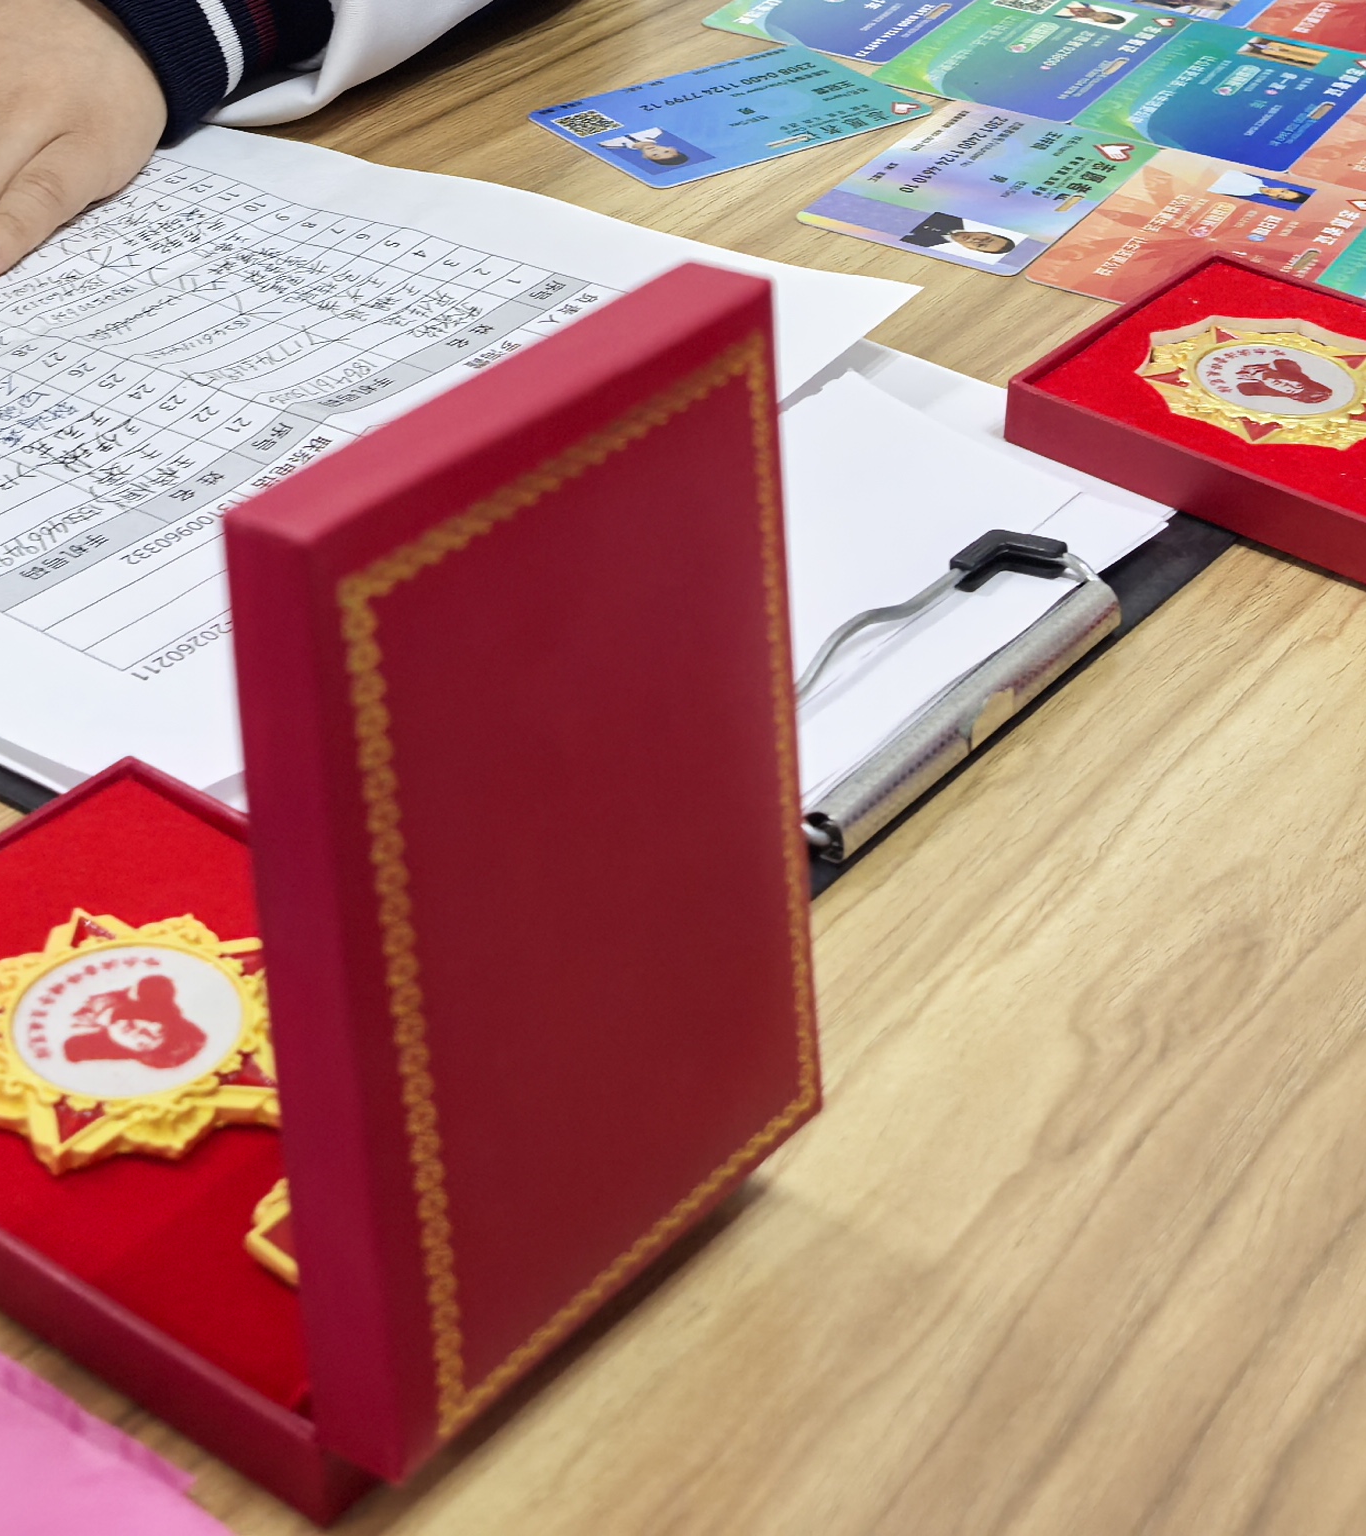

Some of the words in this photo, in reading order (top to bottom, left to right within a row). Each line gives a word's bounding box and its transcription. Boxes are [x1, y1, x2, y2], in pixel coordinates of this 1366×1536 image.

[1116, 25, 1163, 53] 志愿者证
[1321, 67, 1366, 98] 志愿者证
[637, 102, 663, 111] 12
[974, 115, 1008, 133] 2301
[953, 131, 987, 150] 2400
[932, 148, 965, 166] 1124
[161, 173, 188, 185] 13
[909, 165, 943, 183] 4610
[988, 174, 1008, 183] 男
[186, 182, 214, 194] 12
[216, 190, 241, 202] 11
[896, 182, 920, 193] 10
[239, 200, 268, 213] 10
[1310, 208, 1361, 245] 志愿者证
[525, 279, 570, 300] 序号
[535, 292, 602, 326] 负责人
[443, 322, 497, 349] 姓名
[9, 342, 40, 359] 28
[36, 351, 69, 368] 27
[65, 361, 98, 379] 26
[94, 372, 128, 390] 25
[123, 382, 158, 401] 24
[153, 394, 190, 412] 23
[187, 405, 222, 423] 22
[221, 417, 255, 433] 21
[243, 422, 301, 452] 序号
[239, 435, 343, 491] 联系电话
[168, 470, 227, 502] 姓名
[17, 530, 111, 583] 手机号码
